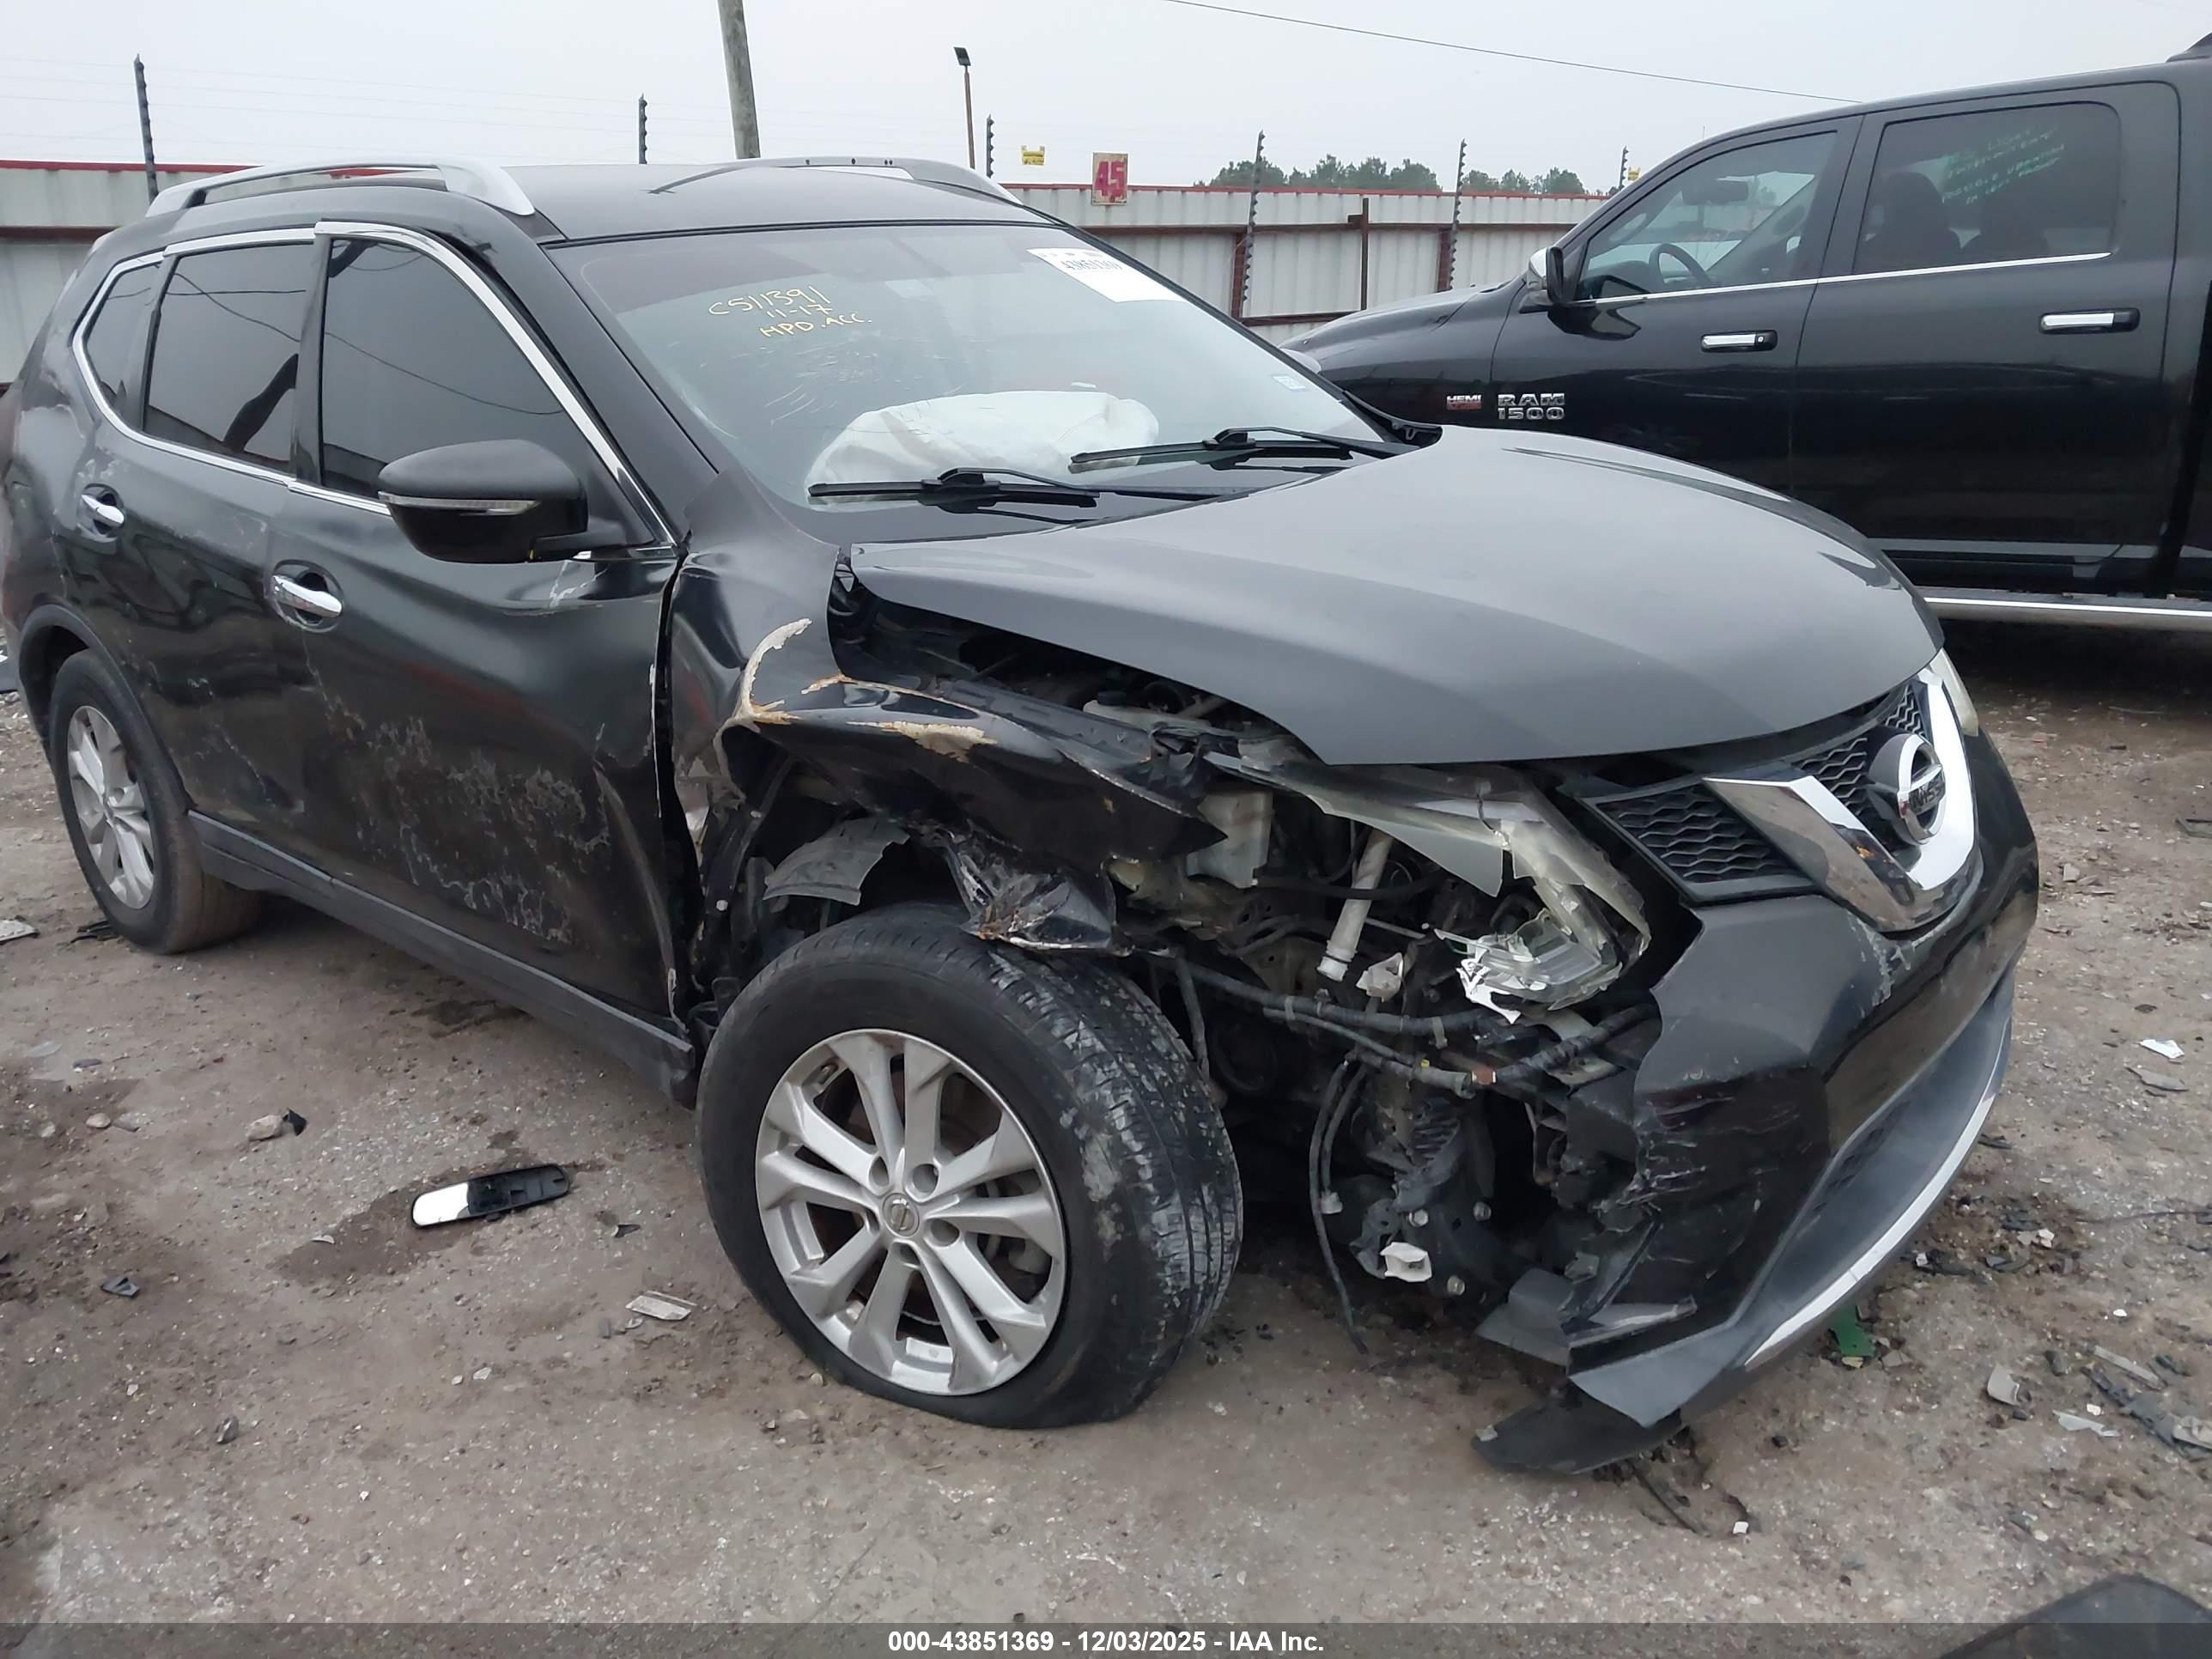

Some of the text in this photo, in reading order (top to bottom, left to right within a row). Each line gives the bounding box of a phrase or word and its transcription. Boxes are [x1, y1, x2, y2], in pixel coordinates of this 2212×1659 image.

[1095, 160, 1126, 198] 45
[1497, 393, 1565, 406] RAM
[1497, 407, 1565, 420] 1500
